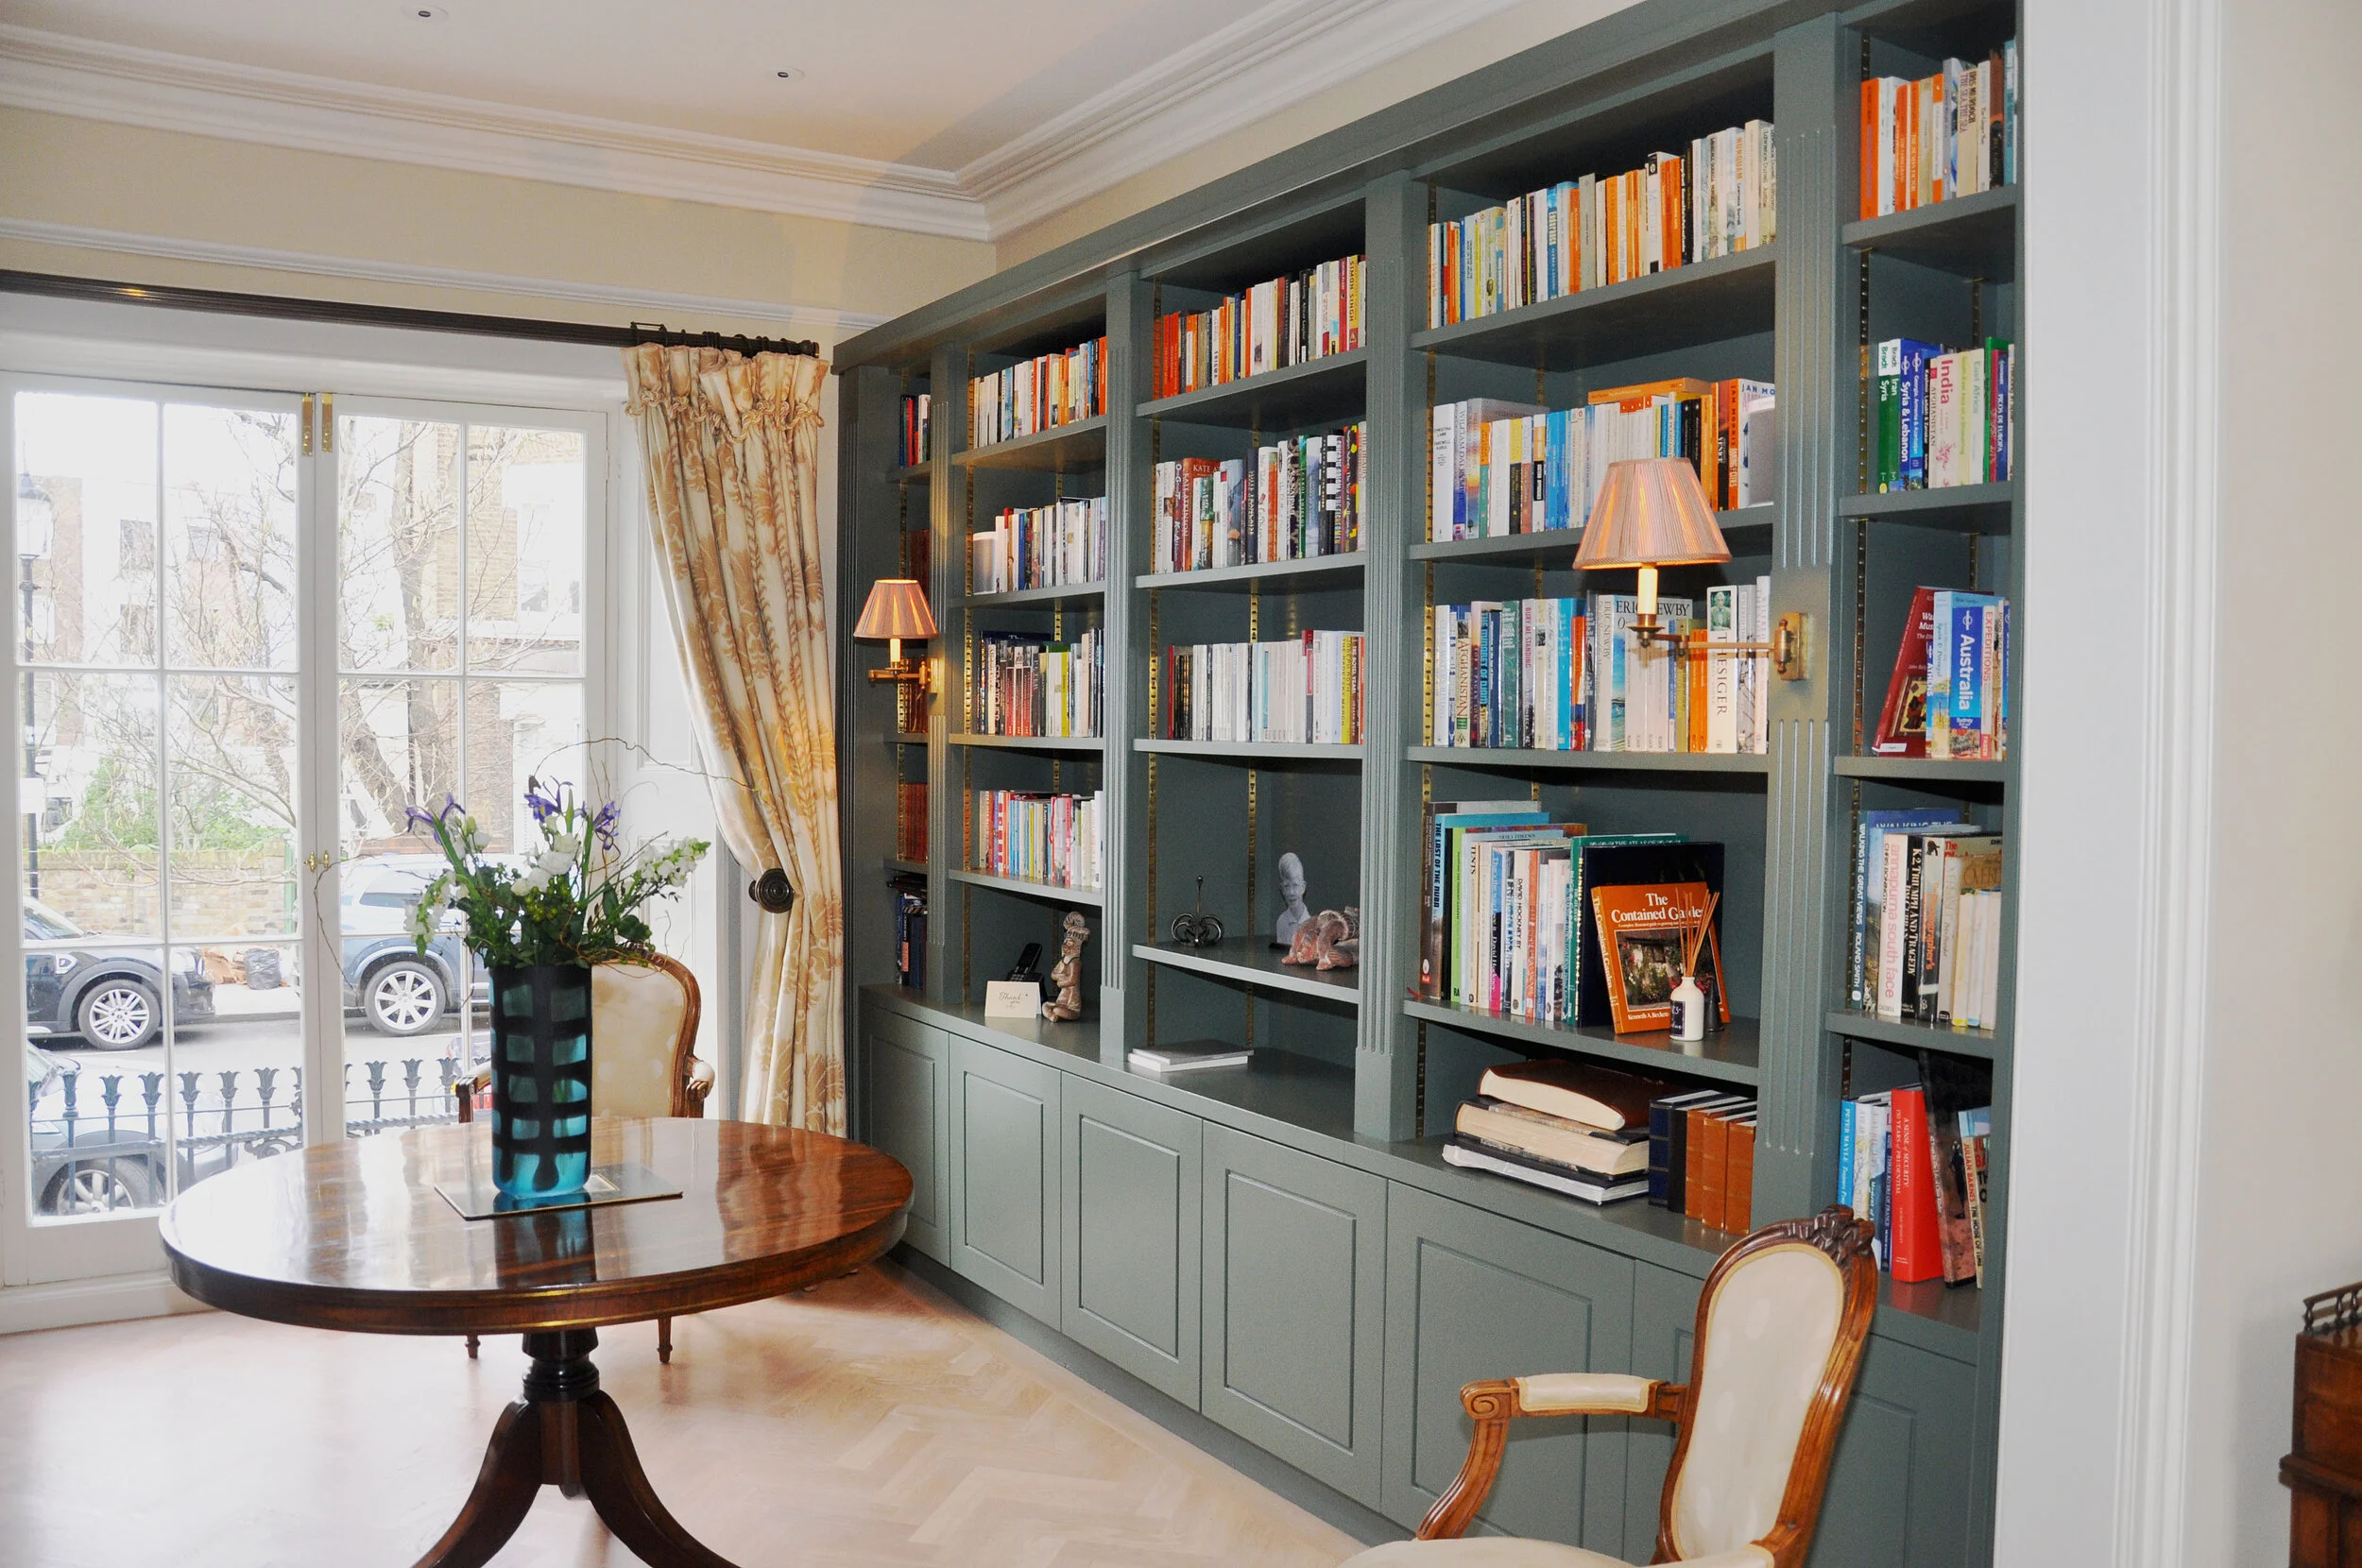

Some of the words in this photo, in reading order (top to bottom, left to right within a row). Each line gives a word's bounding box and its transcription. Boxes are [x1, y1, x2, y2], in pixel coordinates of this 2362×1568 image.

[1879, 380, 1889, 401] Syria
[1901, 382, 1910, 406] Syria
[1940, 359, 1953, 404] India
[1973, 384, 1981, 415] Africa
[1901, 418, 1909, 462] Lebanon
[1525, 626, 1532, 636] ME
[1602, 624, 1611, 659] NEWBY
[1983, 611, 1993, 682] EXPEDITIONS
[1456, 639, 1467, 717] AFGHANISTAN
[1481, 669, 1487, 678] OF
[1959, 634, 1976, 710] Australia
[1945, 841, 1958, 849] The
[1434, 859, 1442, 870] OF
[1887, 844, 1900, 920] annapurna
[1909, 867, 1921, 910] TRIUMPH
[1611, 907, 1666, 923] Contained
[1669, 906, 1703, 920] Gade
[1646, 894, 1668, 906] The
[1908, 911, 1919, 932] AND
[1516, 940, 1522, 949] BY
[1596, 914, 1608, 956] Contained
[1602, 958, 1613, 988] Garden
[1887, 923, 1897, 964] south
[1908, 932, 1918, 976] TRAGEDY
[1886, 967, 1897, 998] face
[1963, 1143, 1972, 1171] JULIAN
[1967, 1172, 1977, 1202] BARNES
